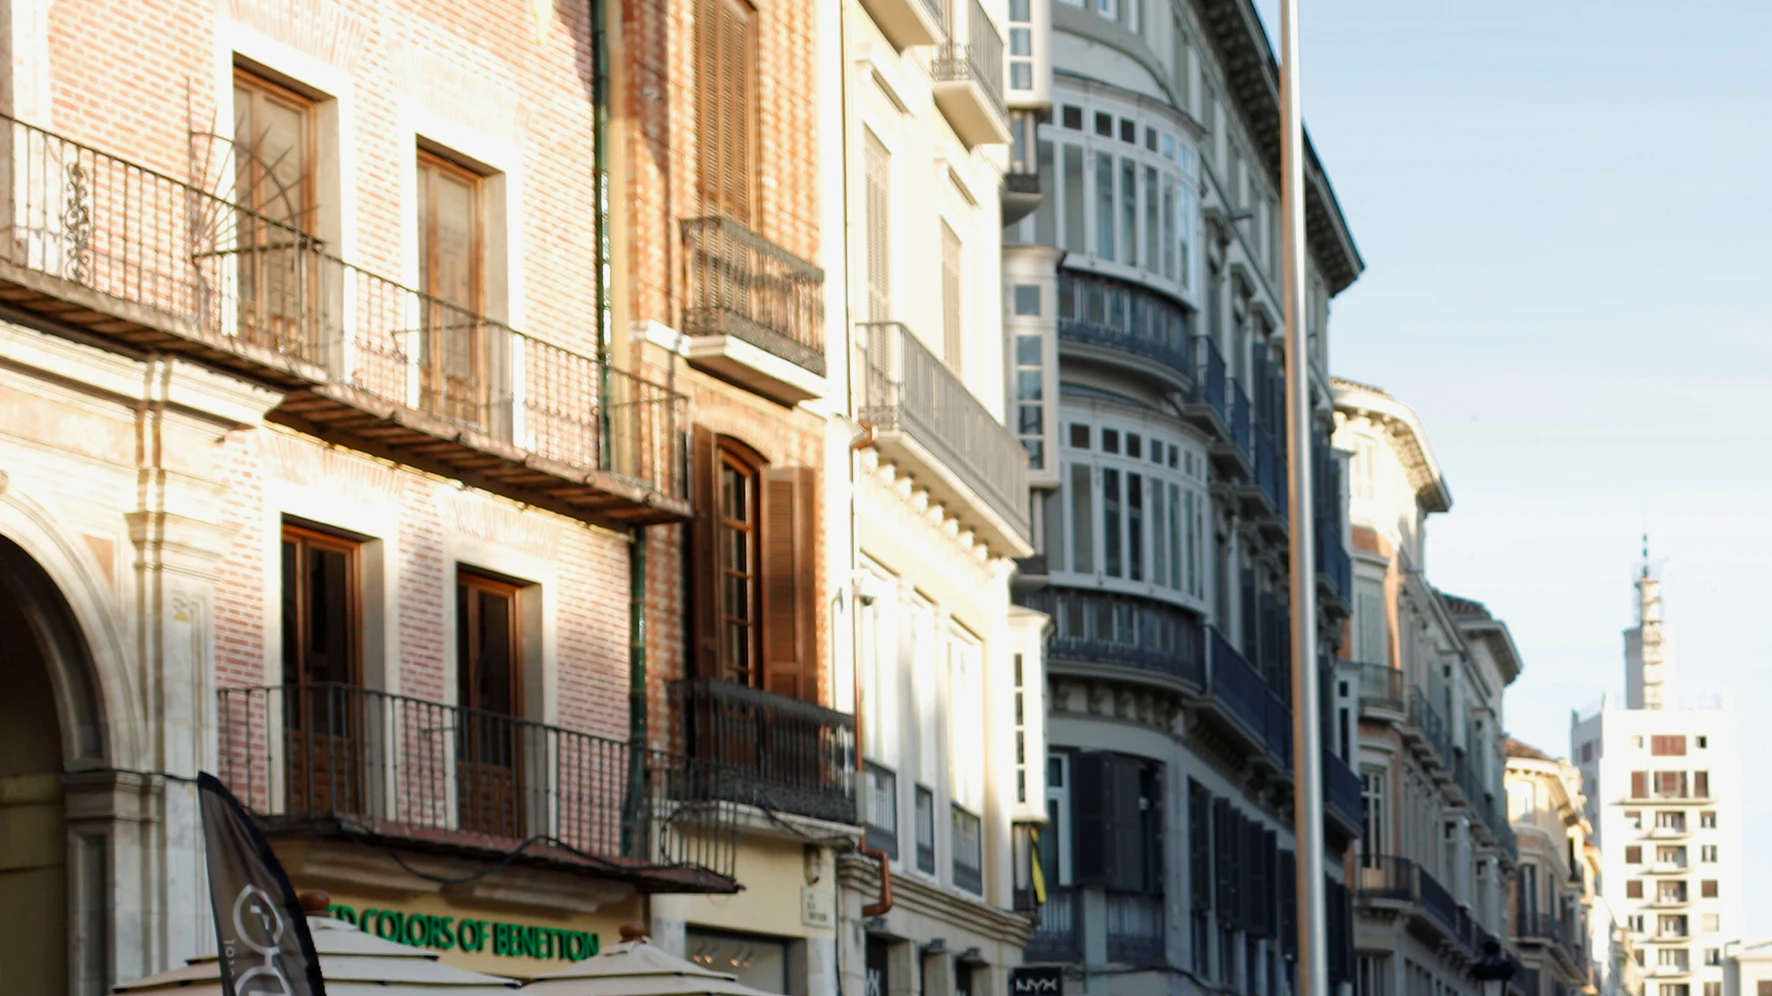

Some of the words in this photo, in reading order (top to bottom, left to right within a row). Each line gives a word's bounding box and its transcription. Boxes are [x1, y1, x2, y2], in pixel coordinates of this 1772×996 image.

[362, 907, 456, 950] COLORS
[457, 918, 491, 952] OF
[493, 922, 601, 963] BENETTON
[1016, 977, 1058, 995] NYX
